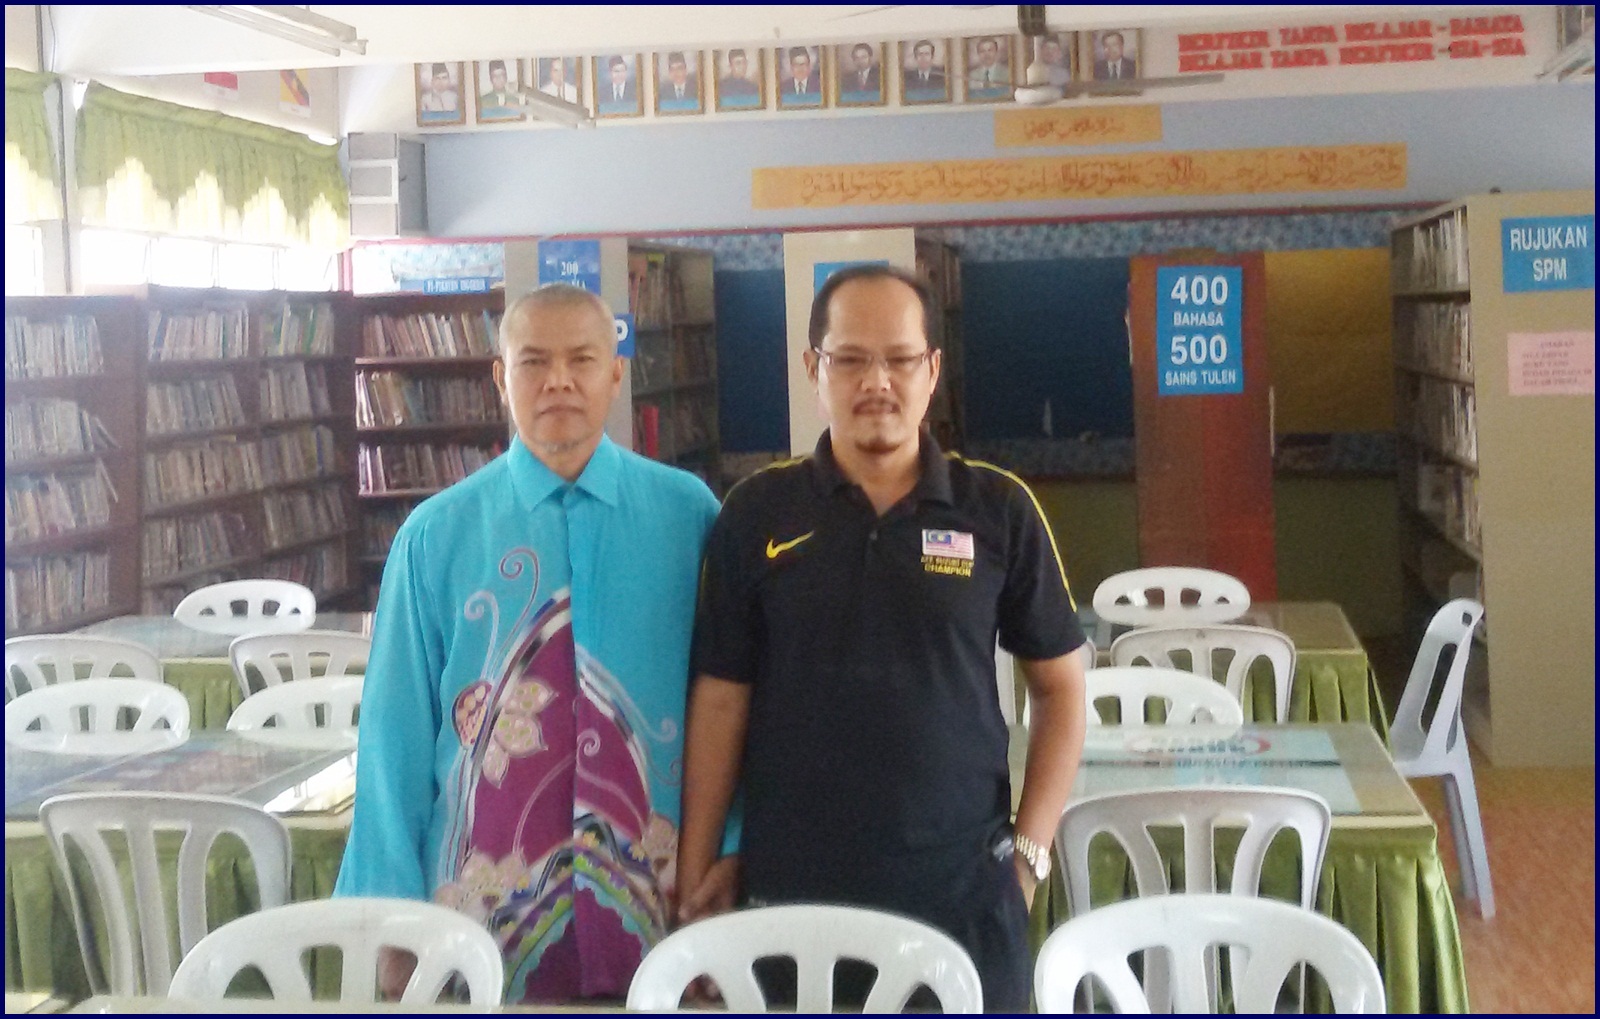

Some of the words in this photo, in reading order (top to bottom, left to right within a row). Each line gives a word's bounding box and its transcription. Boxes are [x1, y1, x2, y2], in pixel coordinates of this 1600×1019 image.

[1279, 25, 1339, 46] TANPA
[1344, 19, 1433, 42] BELAJAR
[1270, 48, 1329, 69] TANPA
[1510, 225, 1588, 252] RUJUKAN
[560, 261, 579, 276] 200
[1532, 257, 1567, 282] SPM
[1170, 275, 1229, 305] 400
[1173, 311, 1224, 327] BAHASA
[1170, 335, 1228, 365] 500
[1165, 371, 1198, 386] SAINS
[1201, 369, 1236, 385] TULEN
[924, 563, 971, 577] CHAMPION
